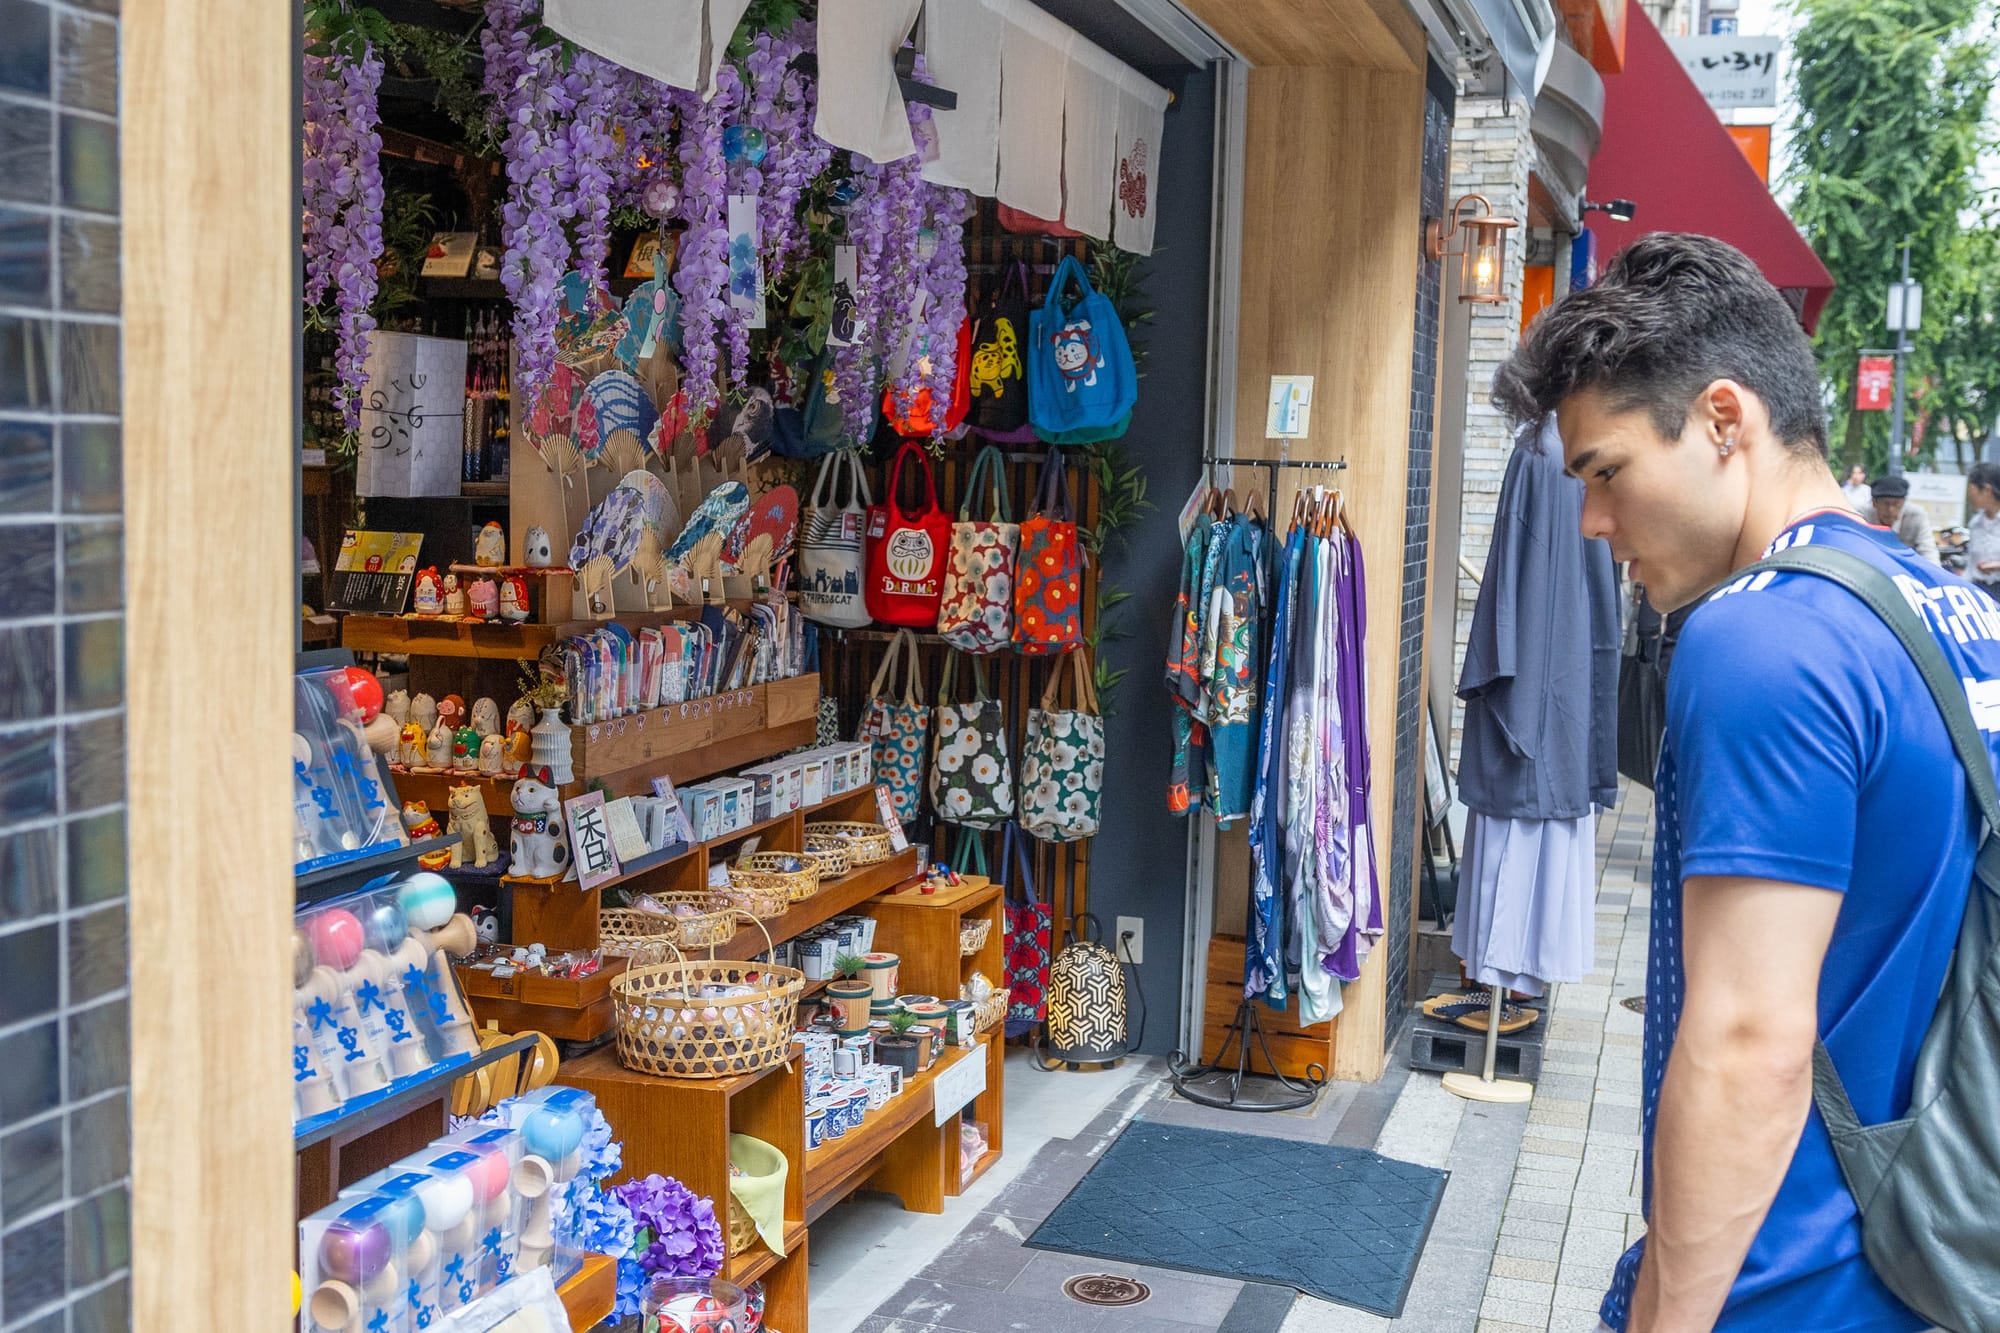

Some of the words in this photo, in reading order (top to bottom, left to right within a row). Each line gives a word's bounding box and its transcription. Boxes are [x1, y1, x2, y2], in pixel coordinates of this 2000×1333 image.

[1701, 51, 1773, 75] いろり
[802, 592, 852, 605] STRIPED&CAT
[885, 580, 933, 593] DARUMA
[356, 979, 412, 1043] 大空
[403, 963, 455, 1026] 大空
[308, 996, 366, 1062] 大空
